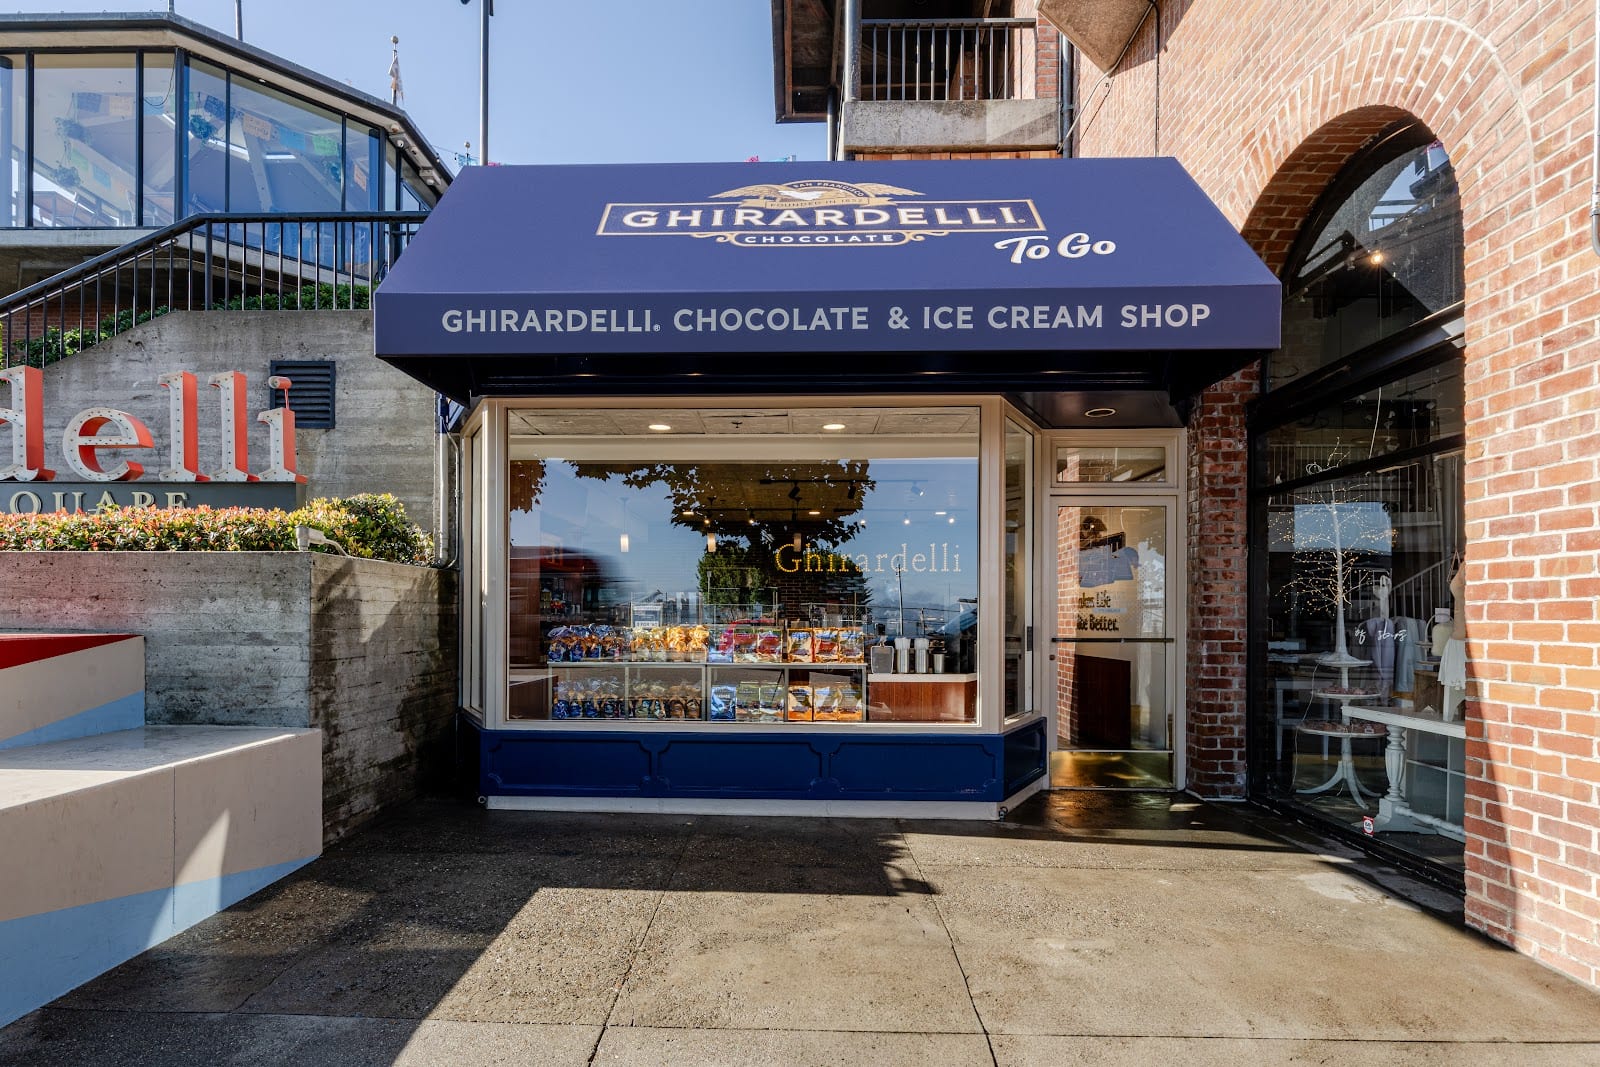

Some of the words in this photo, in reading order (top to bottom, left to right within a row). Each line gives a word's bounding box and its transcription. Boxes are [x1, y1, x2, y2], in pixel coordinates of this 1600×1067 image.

[744, 233, 895, 244] CHOCOLATE
[994, 235, 1050, 264] To
[1057, 232, 1117, 259] Go
[673, 306, 869, 332] CHOCOLATE
[887, 306, 911, 330] &
[923, 306, 974, 330] ICE
[987, 304, 1103, 329] CREAM
[1120, 303, 1211, 328] SHOP
[775, 542, 962, 573] Ghirardelli
